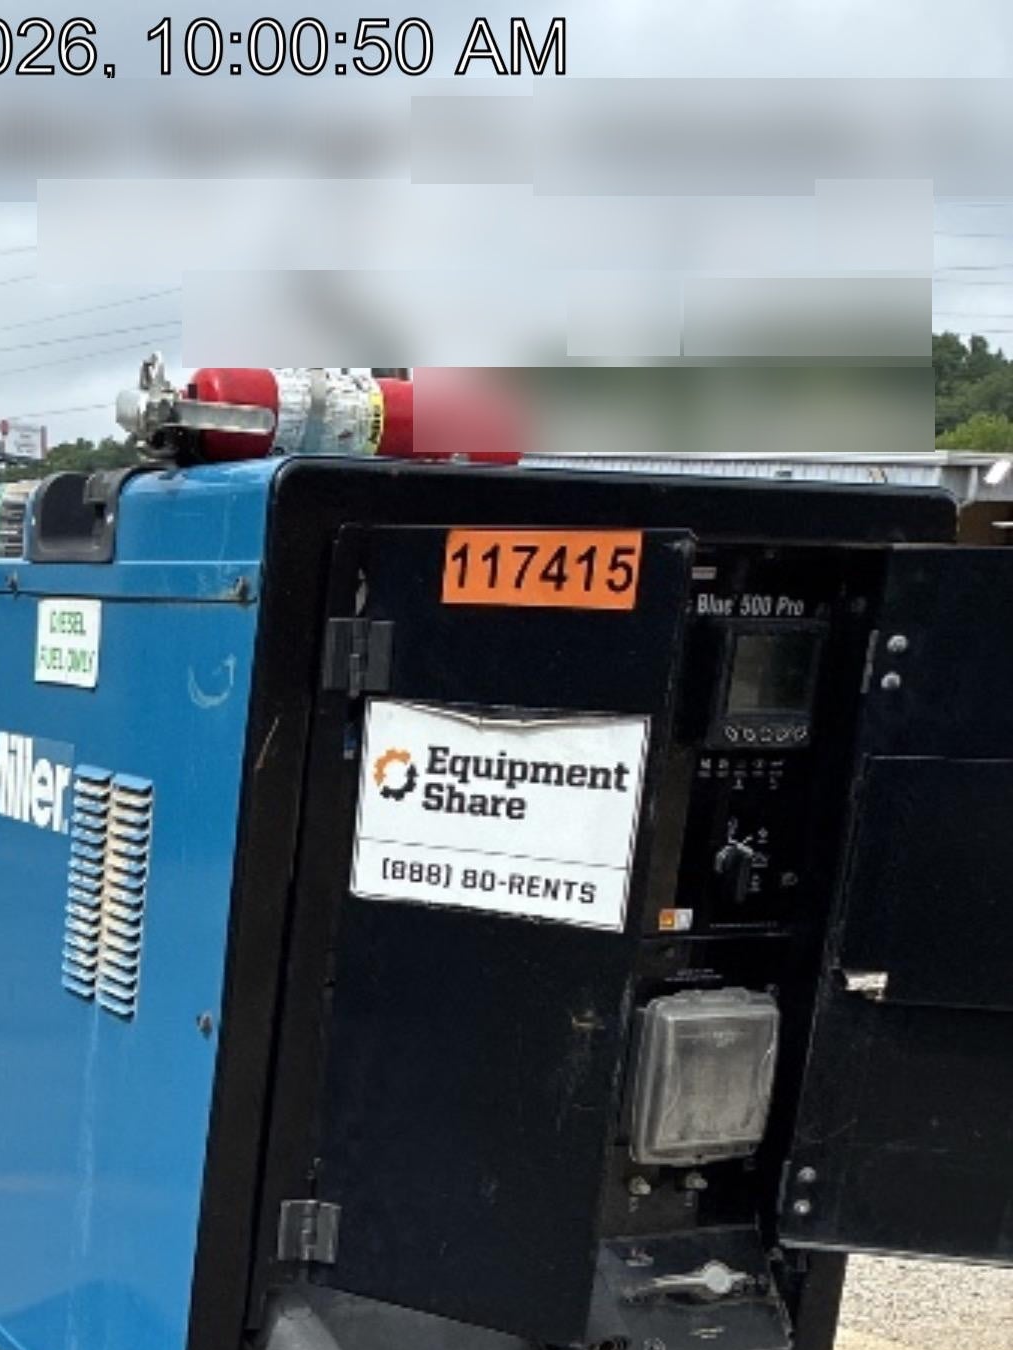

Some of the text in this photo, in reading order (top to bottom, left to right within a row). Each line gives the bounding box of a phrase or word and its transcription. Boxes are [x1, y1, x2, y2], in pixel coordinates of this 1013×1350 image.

[450, 543, 637, 592] 117415
[426, 746, 630, 791] Equipment
[422, 783, 527, 820] Share
[461, 869, 597, 904] 80-RENTS
